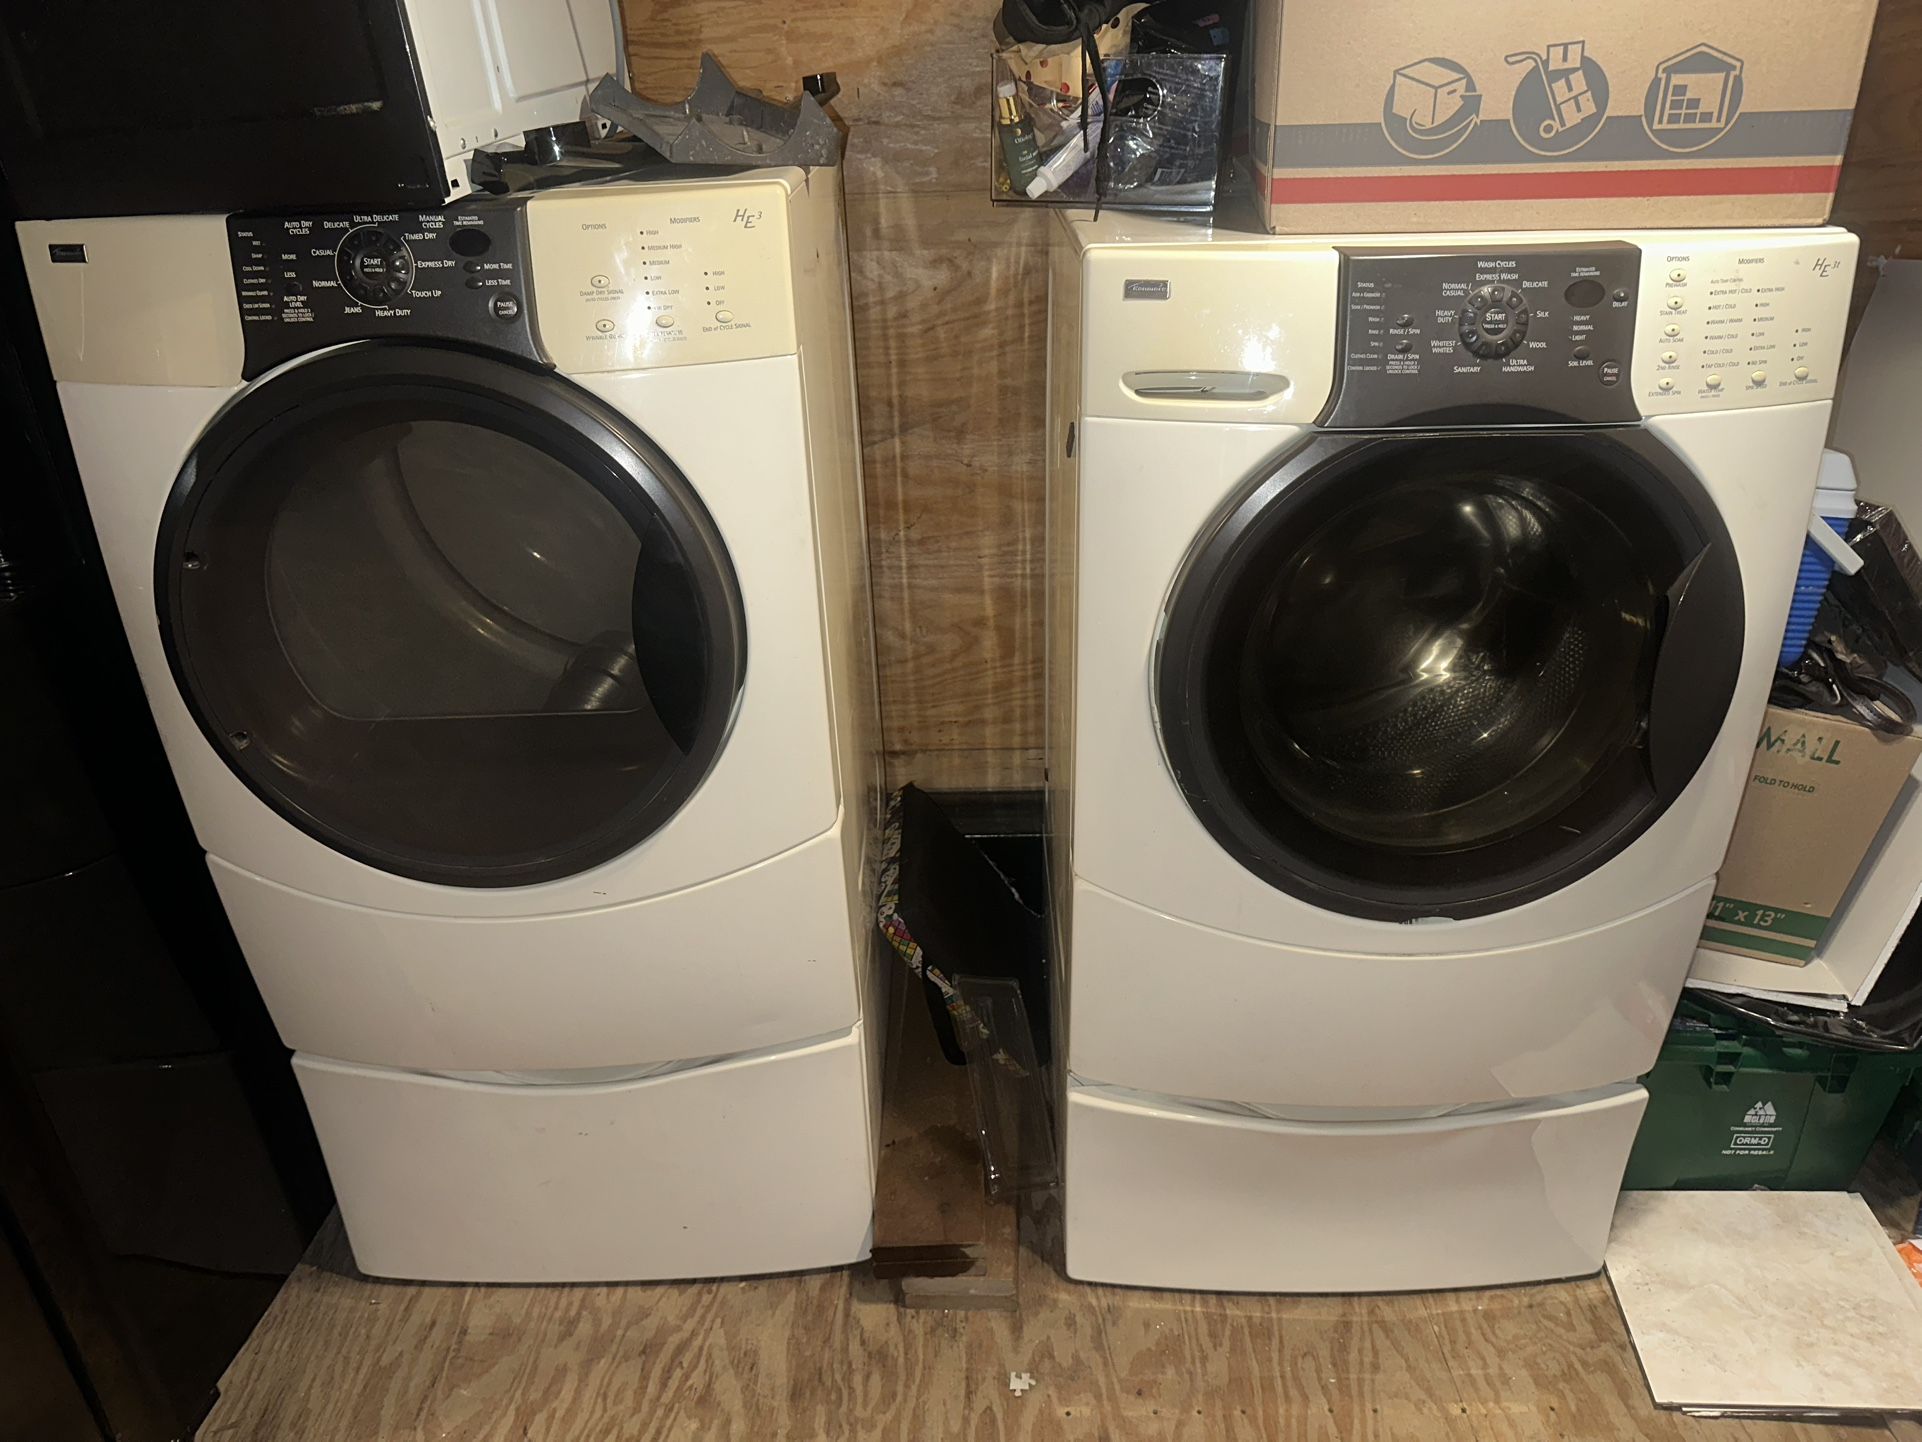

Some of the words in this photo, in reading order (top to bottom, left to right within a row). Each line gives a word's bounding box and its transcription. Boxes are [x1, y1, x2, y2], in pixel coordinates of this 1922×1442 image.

[373, 214, 399, 222] DELICATE
[419, 214, 445, 222] MANUAL
[669, 216, 701, 225] MODIFIERS
[284, 221, 300, 229] AUTO
[324, 221, 350, 229] DELICATE
[422, 221, 444, 229] CYCLES
[581, 223, 607, 231] OPTIONS
[424, 232, 437, 240] DRY
[311, 248, 335, 256] CASUAL
[363, 257, 381, 266] START
[1666, 255, 1690, 263] OPTIONS
[417, 260, 442, 268] EXPRESS
[443, 259, 456, 267] DRY
[1495, 260, 1516, 268] CYCLES
[1476, 273, 1499, 281] EXPRESS
[312, 280, 338, 288] NORMAL
[498, 278, 511, 286] TIME
[1522, 280, 1548, 288] DELICATE
[411, 290, 432, 298] TOUCH
[433, 289, 442, 297] UP
[344, 306, 362, 314] JEANS
[375, 308, 394, 317] HEAVY
[395, 308, 411, 316] DUTY
[1536, 310, 1549, 318] SILK
[1486, 313, 1506, 321] START
[1453, 365, 1481, 373] SANITARY
[1752, 774, 1777, 786] FOLD
[1777, 779, 1790, 788] TO
[1790, 782, 1815, 793] HOLD
[1734, 910, 1749, 922] x
[1753, 909, 1786, 926] 13"
[1736, 1137, 1768, 1145] ORM-D
